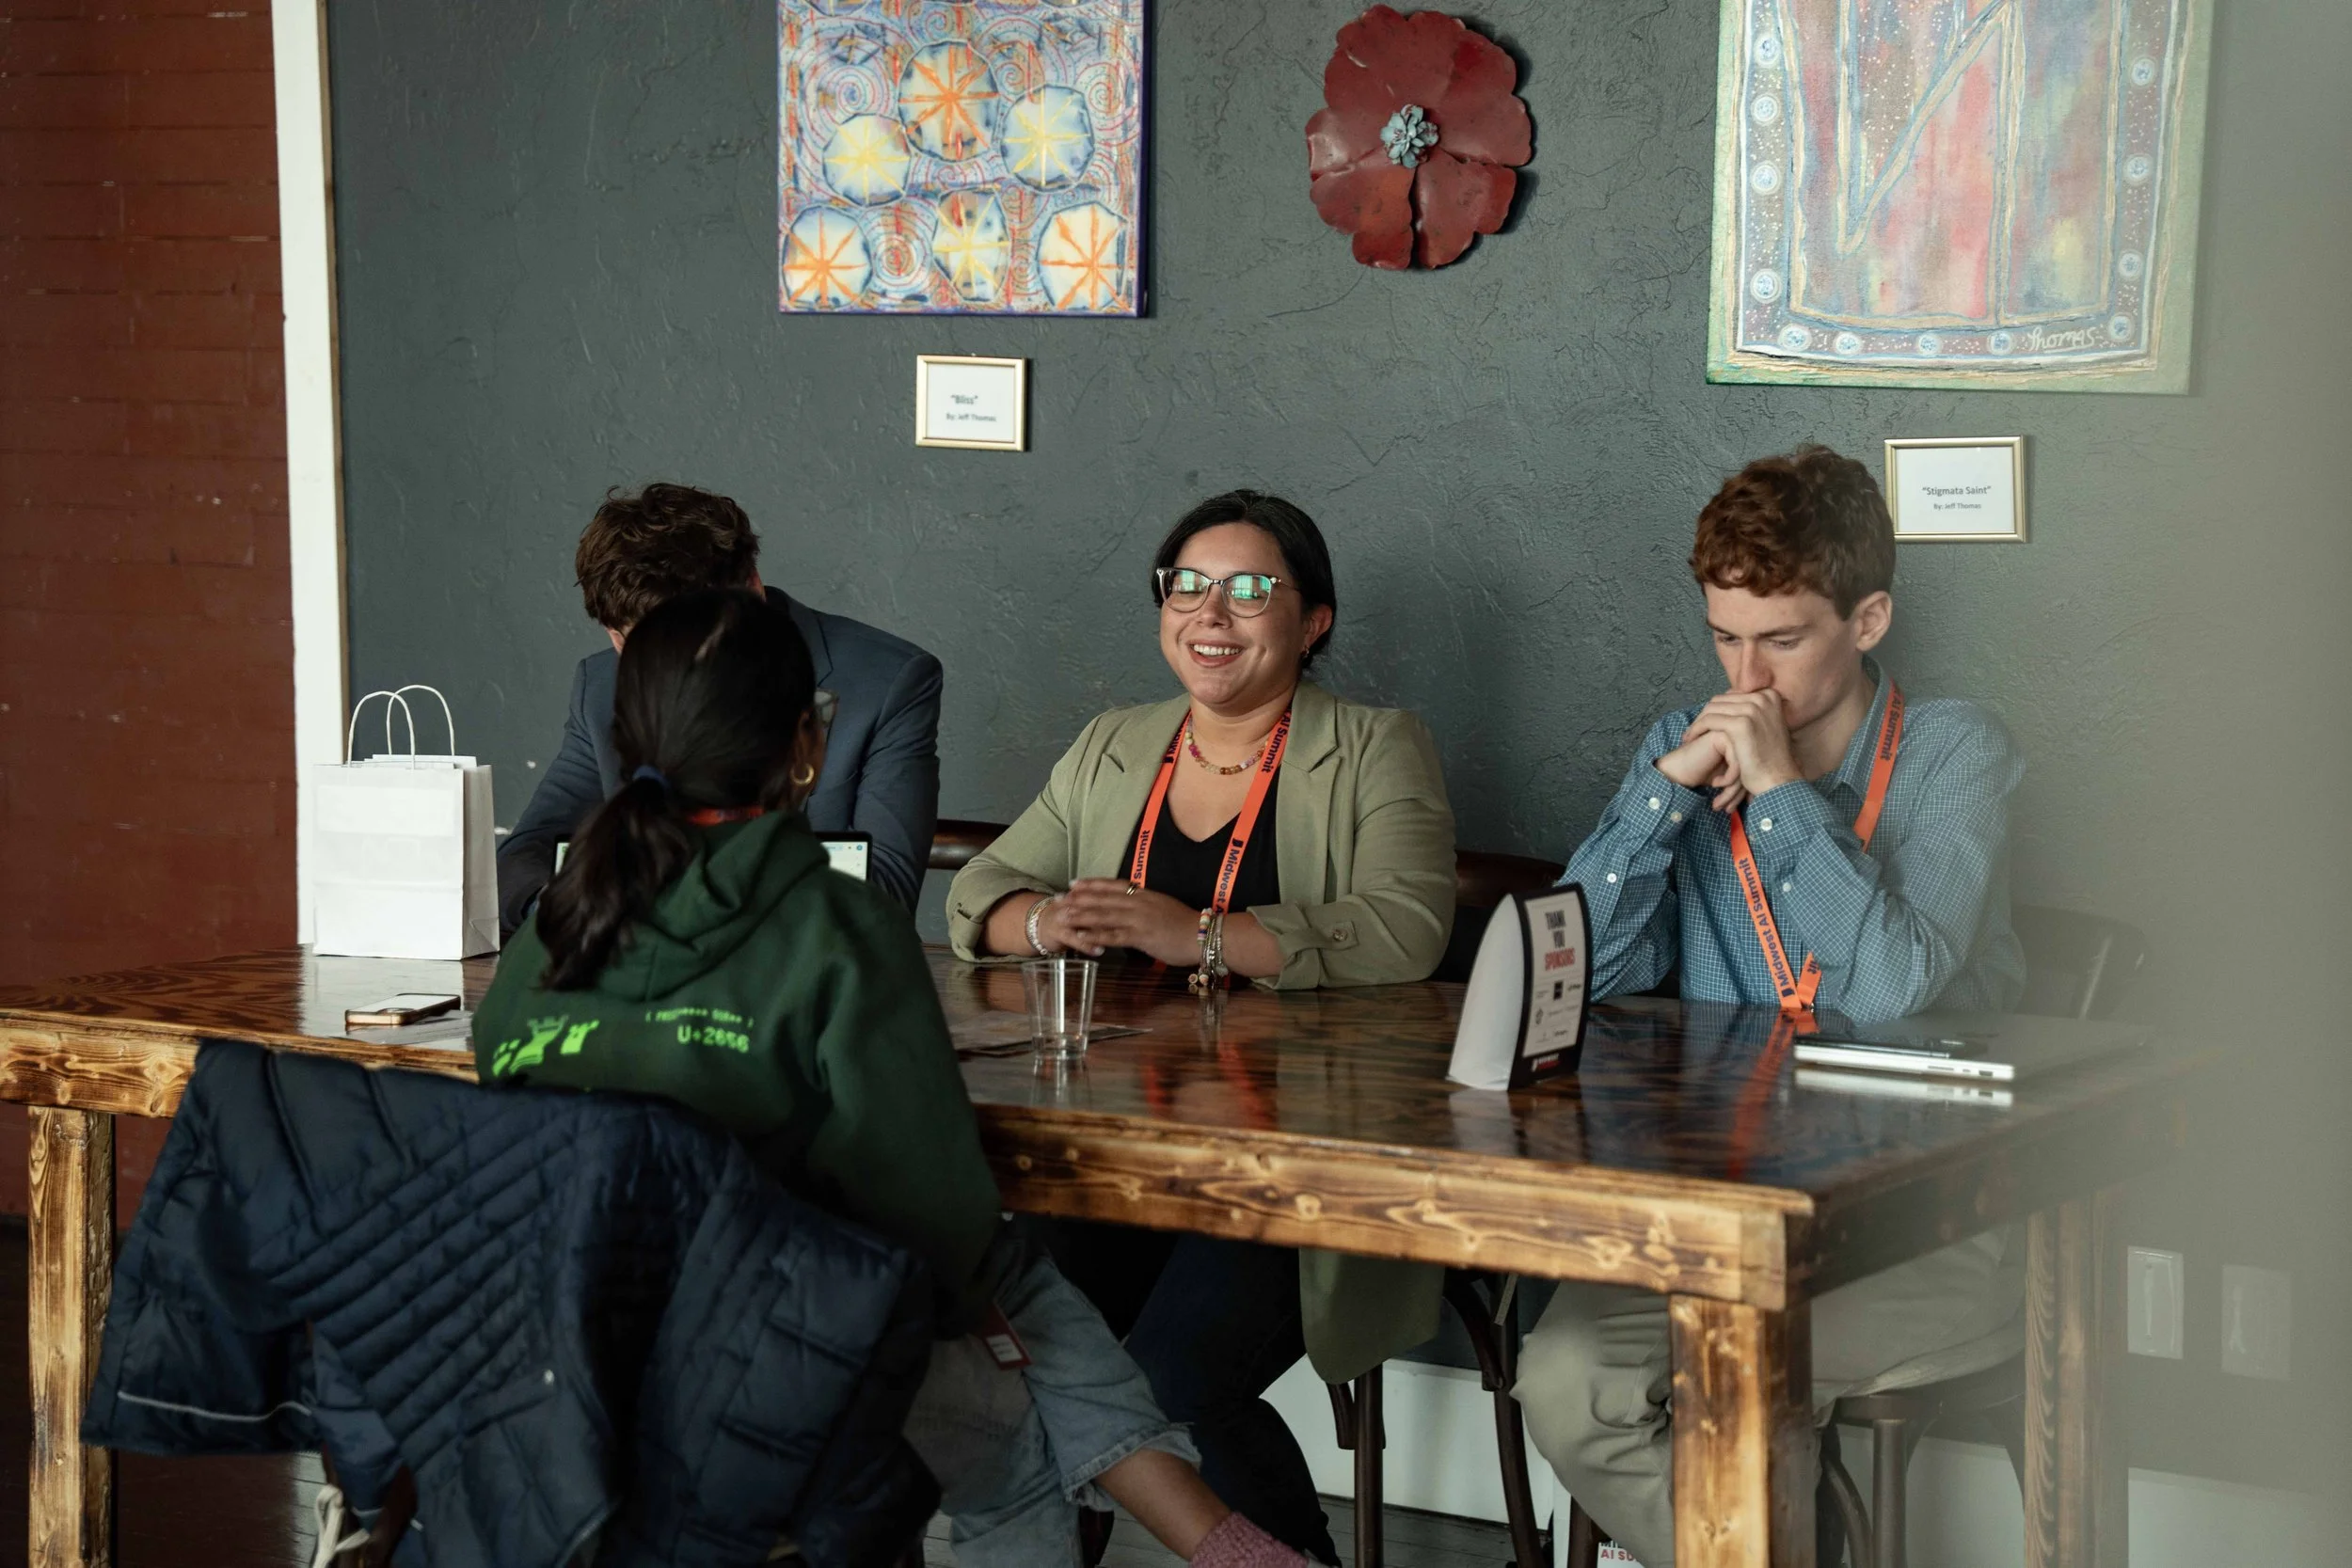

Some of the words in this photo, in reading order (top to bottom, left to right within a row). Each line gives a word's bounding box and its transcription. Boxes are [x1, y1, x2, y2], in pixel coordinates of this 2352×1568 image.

[971, 414, 997, 422] Thomas
[1262, 727, 1288, 773] Summit
[1880, 710, 1899, 761] Summit
[1134, 830, 1151, 879] Summit
[1217, 848, 1240, 903] Midwest
[1739, 857, 1763, 912] Summit
[1756, 912, 1770, 927] AI
[1762, 927, 1790, 987] Midwest
